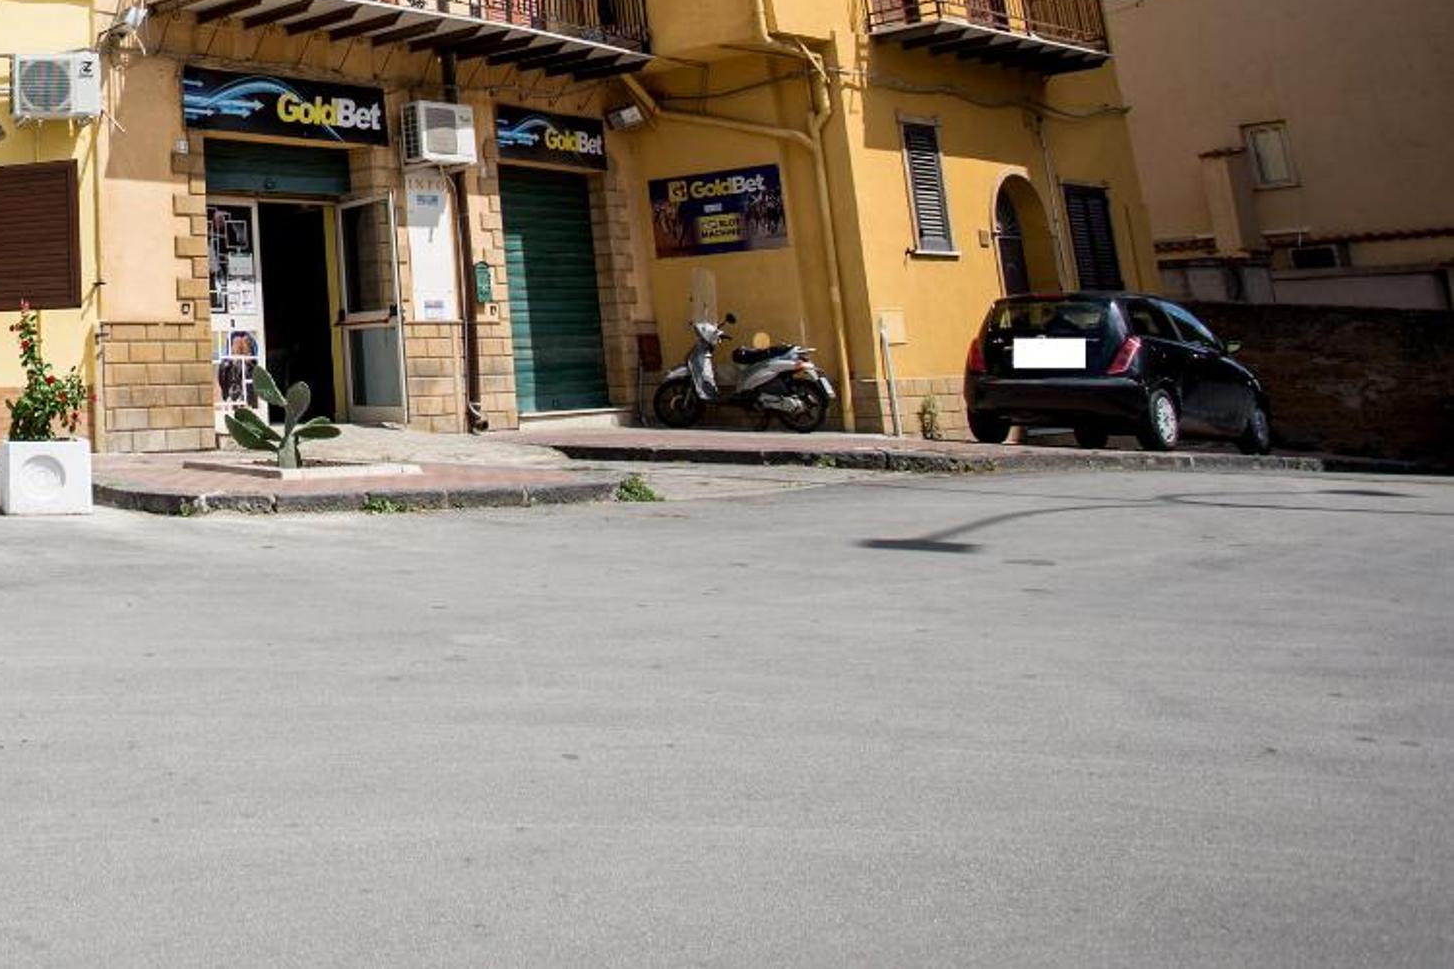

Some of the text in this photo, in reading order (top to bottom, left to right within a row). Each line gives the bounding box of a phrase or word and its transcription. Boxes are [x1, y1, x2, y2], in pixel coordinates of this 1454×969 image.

[277, 92, 380, 130] GoldBet
[545, 129, 602, 155] GoldBet
[690, 174, 765, 198] GoldBet
